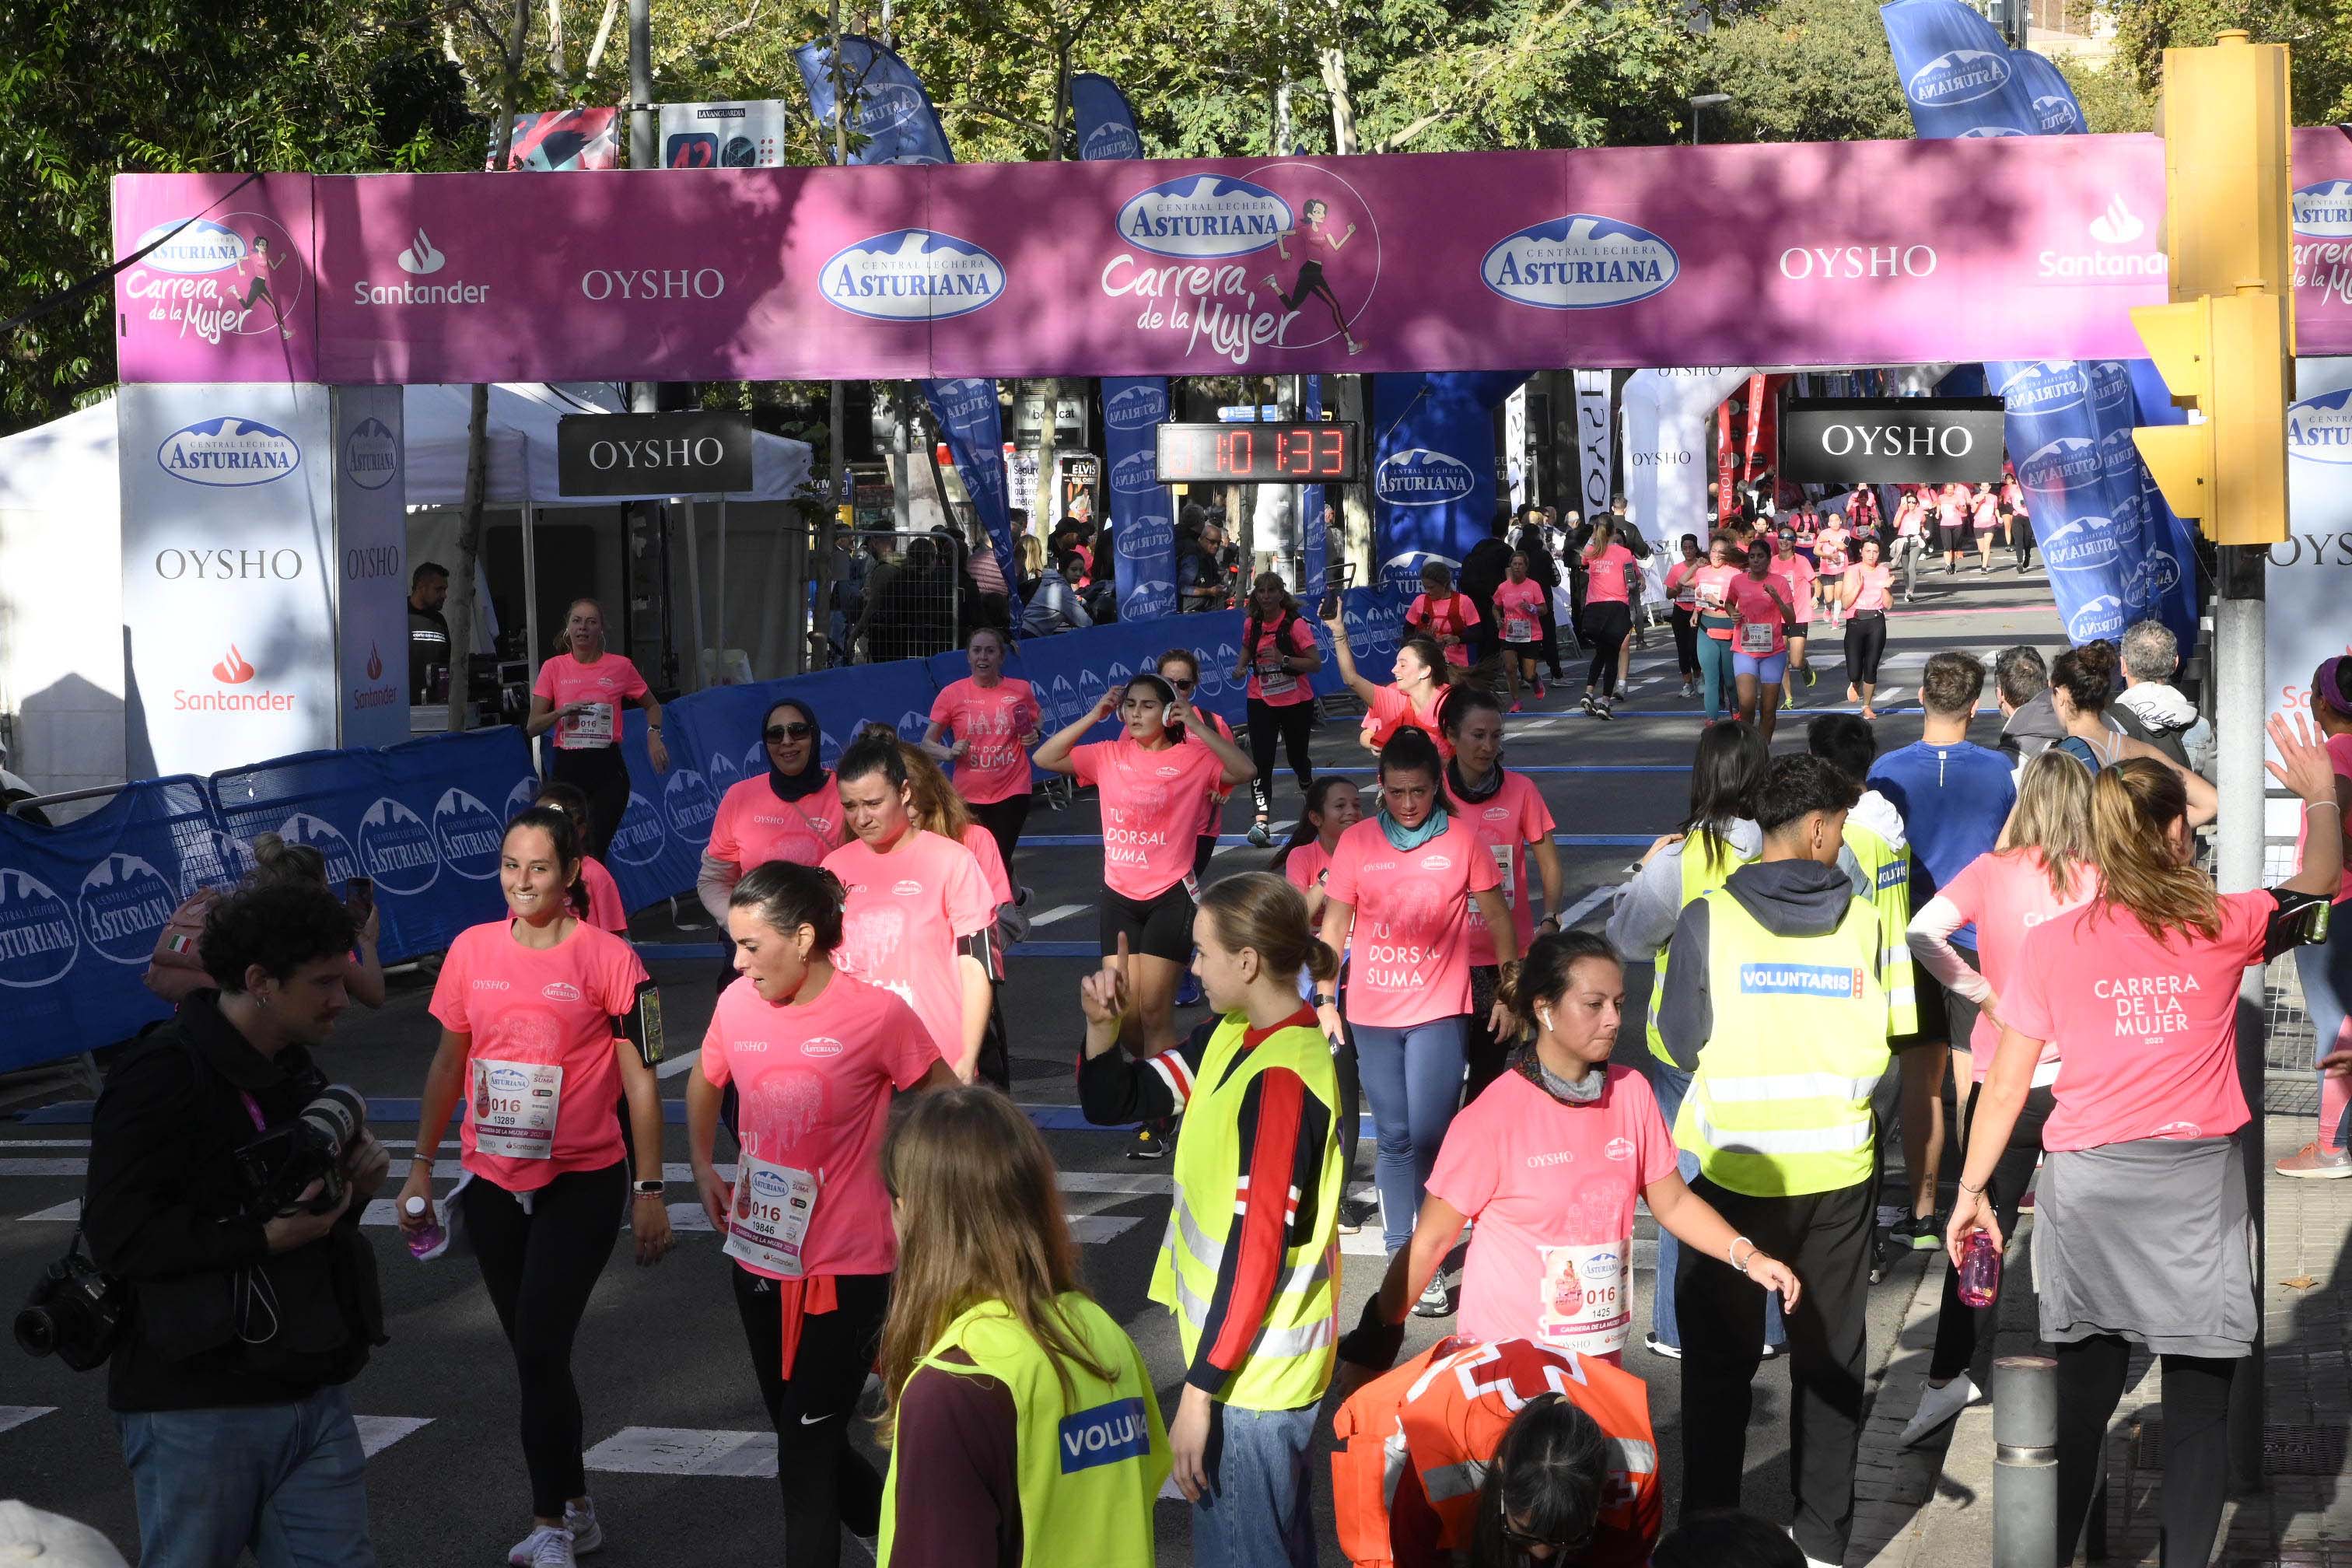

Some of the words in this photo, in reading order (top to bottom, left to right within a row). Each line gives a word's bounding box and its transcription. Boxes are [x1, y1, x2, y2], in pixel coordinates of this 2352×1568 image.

[1156, 202, 1213, 212] CENTRAL
[1217, 201, 1275, 211] LECHERA
[1130, 206, 1280, 238] ASTURIANA
[1526, 247, 1588, 258] CENTRAL
[1593, 244, 1657, 256] LECHERA
[861, 260, 923, 269] CENTRAL
[926, 260, 985, 269] LECHERA
[1496, 251, 1664, 286] ASTURIANA
[1779, 244, 1937, 280] OYSHO
[125, 269, 218, 299] Carrera
[581, 268, 725, 301] OYSHO
[834, 264, 992, 297] ASTURIANA
[1101, 253, 1247, 297] Carrera
[2311, 265, 2326, 287] la
[355, 280, 490, 306] Santander
[149, 300, 166, 320] de
[169, 299, 182, 320] la
[180, 296, 253, 345] Mujer
[1136, 304, 1166, 330] de
[1169, 300, 1190, 330] la
[1185, 294, 1302, 366] Mujer
[190, 440, 236, 449] CENTRAL
[240, 440, 286, 449] LECHERA
[1821, 424, 1974, 457] OYSHO
[168, 443, 290, 470] ASTURIANA
[349, 450, 394, 472] ASTURIANA
[588, 436, 724, 471] OYSHO
[1632, 450, 1692, 467] OYSHO
[1072, 464, 1096, 474] ELVIS
[1014, 477, 1027, 486] que
[1379, 472, 1467, 494] ASTURIANA
[156, 548, 303, 581] OYSHO
[347, 544, 399, 581] OYSHO
[173, 689, 296, 712] Santander
[353, 685, 399, 710] Santander
[969, 751, 1017, 768] SUMA
[754, 815, 785, 825] OYSHO
[1108, 807, 1125, 824] TU
[1105, 826, 1167, 845] DORSAL
[366, 837, 437, 875] ASTURIANA
[1363, 861, 1396, 873] OYSHO
[1371, 922, 1391, 940] TU
[1368, 945, 1441, 964] DORSAL
[1366, 968, 1424, 987] SUMA
[1741, 970, 1850, 991] VOLUNTARIS
[2094, 973, 2201, 999] CARRERA
[472, 978, 511, 991] OYSHO
[544, 987, 578, 999] ASTURIANA
[2116, 998, 2146, 1017] DE
[2153, 995, 2184, 1014] LA
[2114, 1013, 2190, 1038] MUJER
[733, 1041, 768, 1053] OYSHO
[803, 1044, 841, 1054] ASTURIANA
[490, 1076, 527, 1087] ASTURIANA
[491, 1097, 522, 1113] 016
[494, 1115, 516, 1125] 13289
[512, 1143, 544, 1152] Santander
[740, 1131, 760, 1157] TU
[1527, 1150, 1574, 1168] OYSHO
[753, 1177, 787, 1195] ASTURIANA
[791, 1183, 810, 1195] SUMA
[751, 1201, 782, 1222] 016
[752, 1220, 775, 1235] 19846
[732, 1240, 752, 1255] OYSHO
[769, 1254, 794, 1269] Santander
[766, 1239, 784, 1250] MUJER
[1586, 1286, 1615, 1305] 016
[1592, 1307, 1611, 1319] 1425
[1560, 1323, 1591, 1334] CARRERA
[1591, 1322, 1599, 1331] DE
[1599, 1321, 1607, 1329] LA
